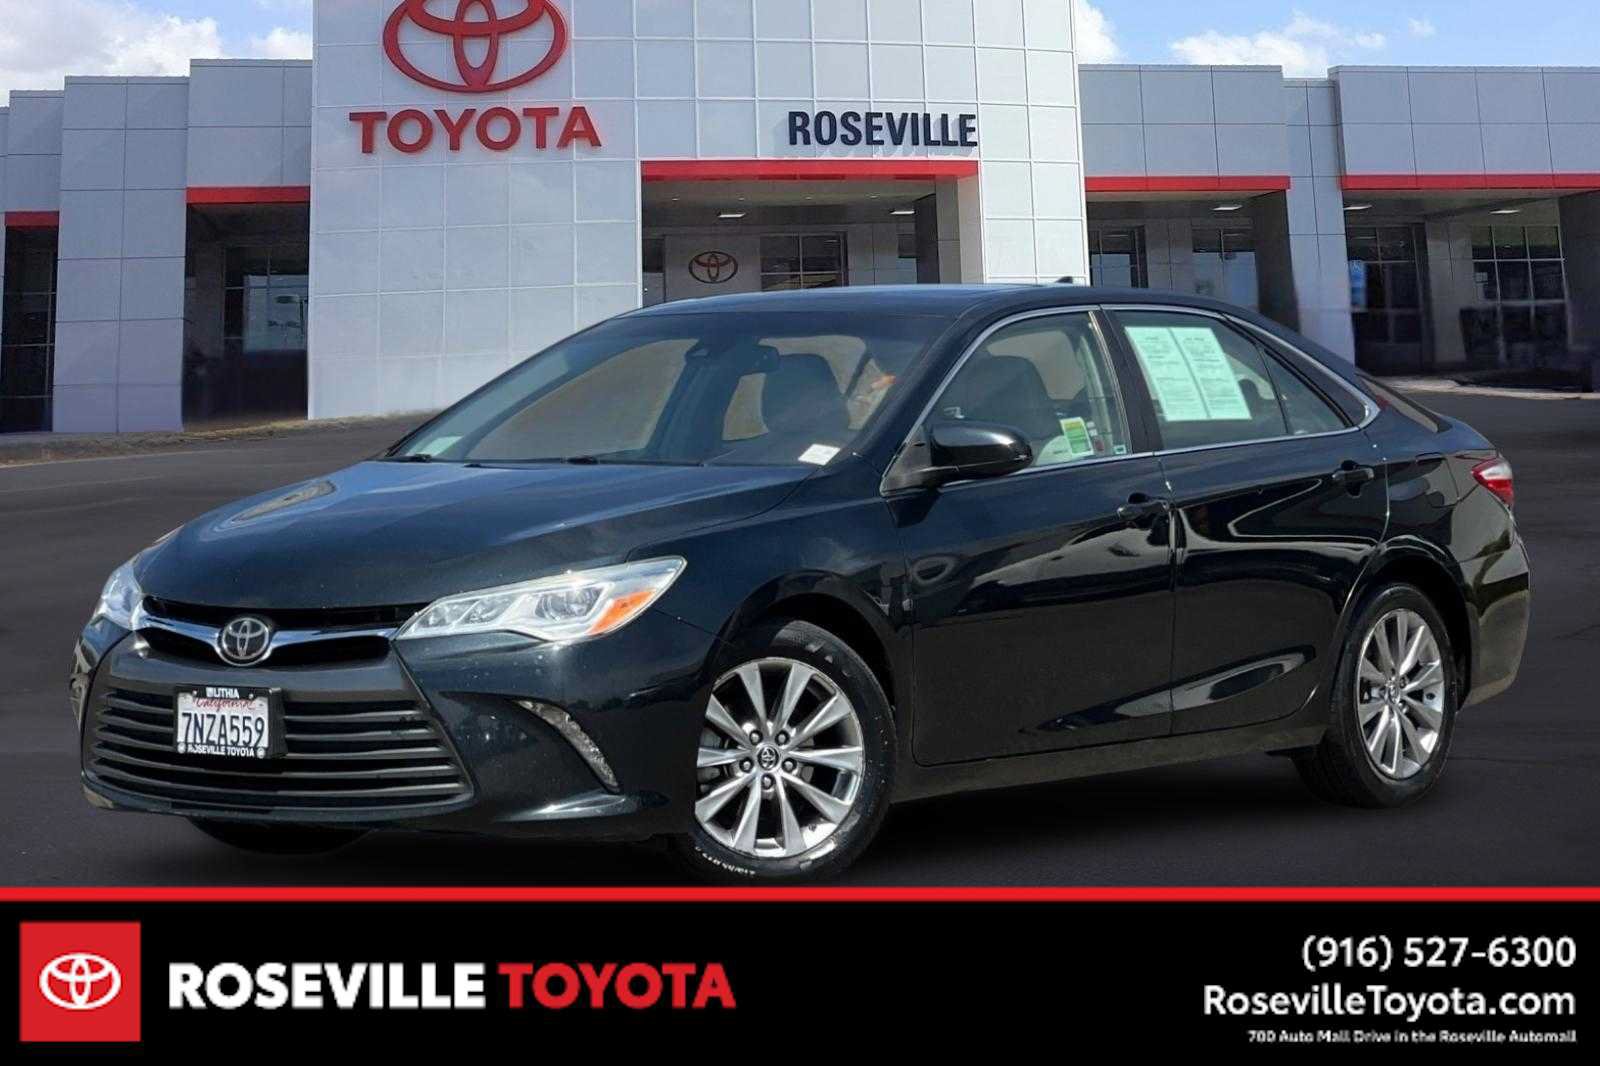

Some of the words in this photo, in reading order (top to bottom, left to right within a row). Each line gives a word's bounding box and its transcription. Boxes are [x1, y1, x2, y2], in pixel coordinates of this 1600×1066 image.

[349, 106, 602, 154] TOYOTA
[788, 111, 978, 147] ROSEVILLE
[182, 712, 265, 748] 7NZA559
[227, 746, 255, 757] TOYOTA
